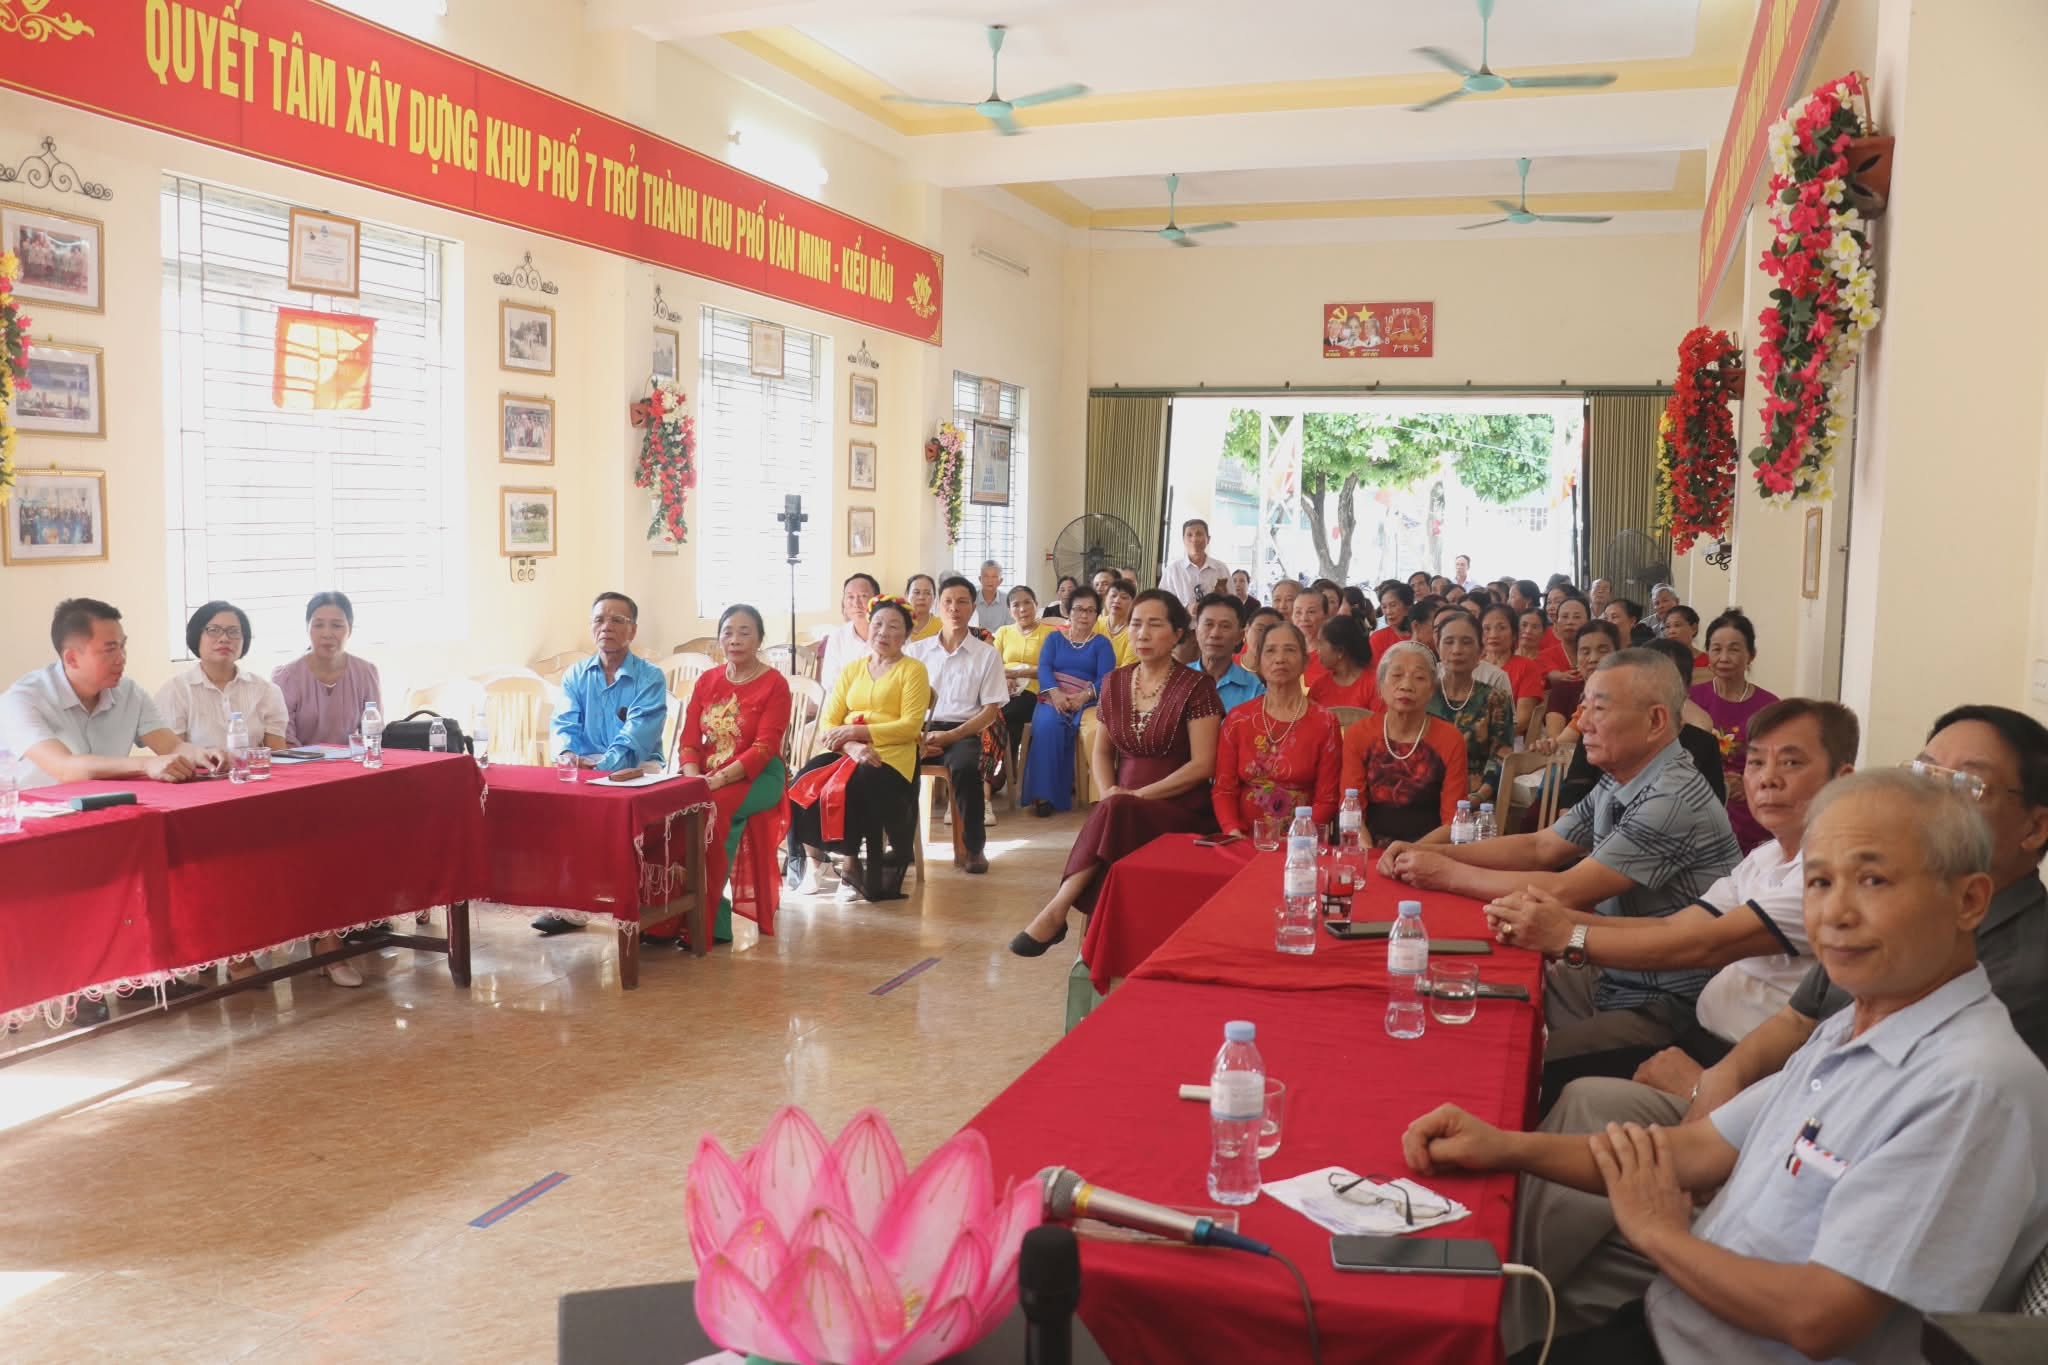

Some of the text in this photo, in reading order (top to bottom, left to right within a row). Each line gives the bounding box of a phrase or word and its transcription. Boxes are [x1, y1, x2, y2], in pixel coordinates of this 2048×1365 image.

[145, 0, 259, 103] QUYẾT
[268, 31, 337, 129] TÂM
[345, 60, 402, 147] XÂY
[409, 88, 479, 175] DỰNG
[486, 116, 532, 188] KHU
[537, 127, 581, 203] PHỐ
[585, 152, 598, 207] 7
[602, 143, 639, 221] TRỞ
[643, 169, 698, 240] THÀNH
[702, 194, 733, 251] KHU
[736, 200, 767, 262] PHỐ
[768, 212, 795, 272] VĂN
[798, 230, 832, 284] MINH
[842, 235, 868, 296] KIỂU
[870, 245, 894, 305] MẪU
[1384, 315, 1393, 324] 10
